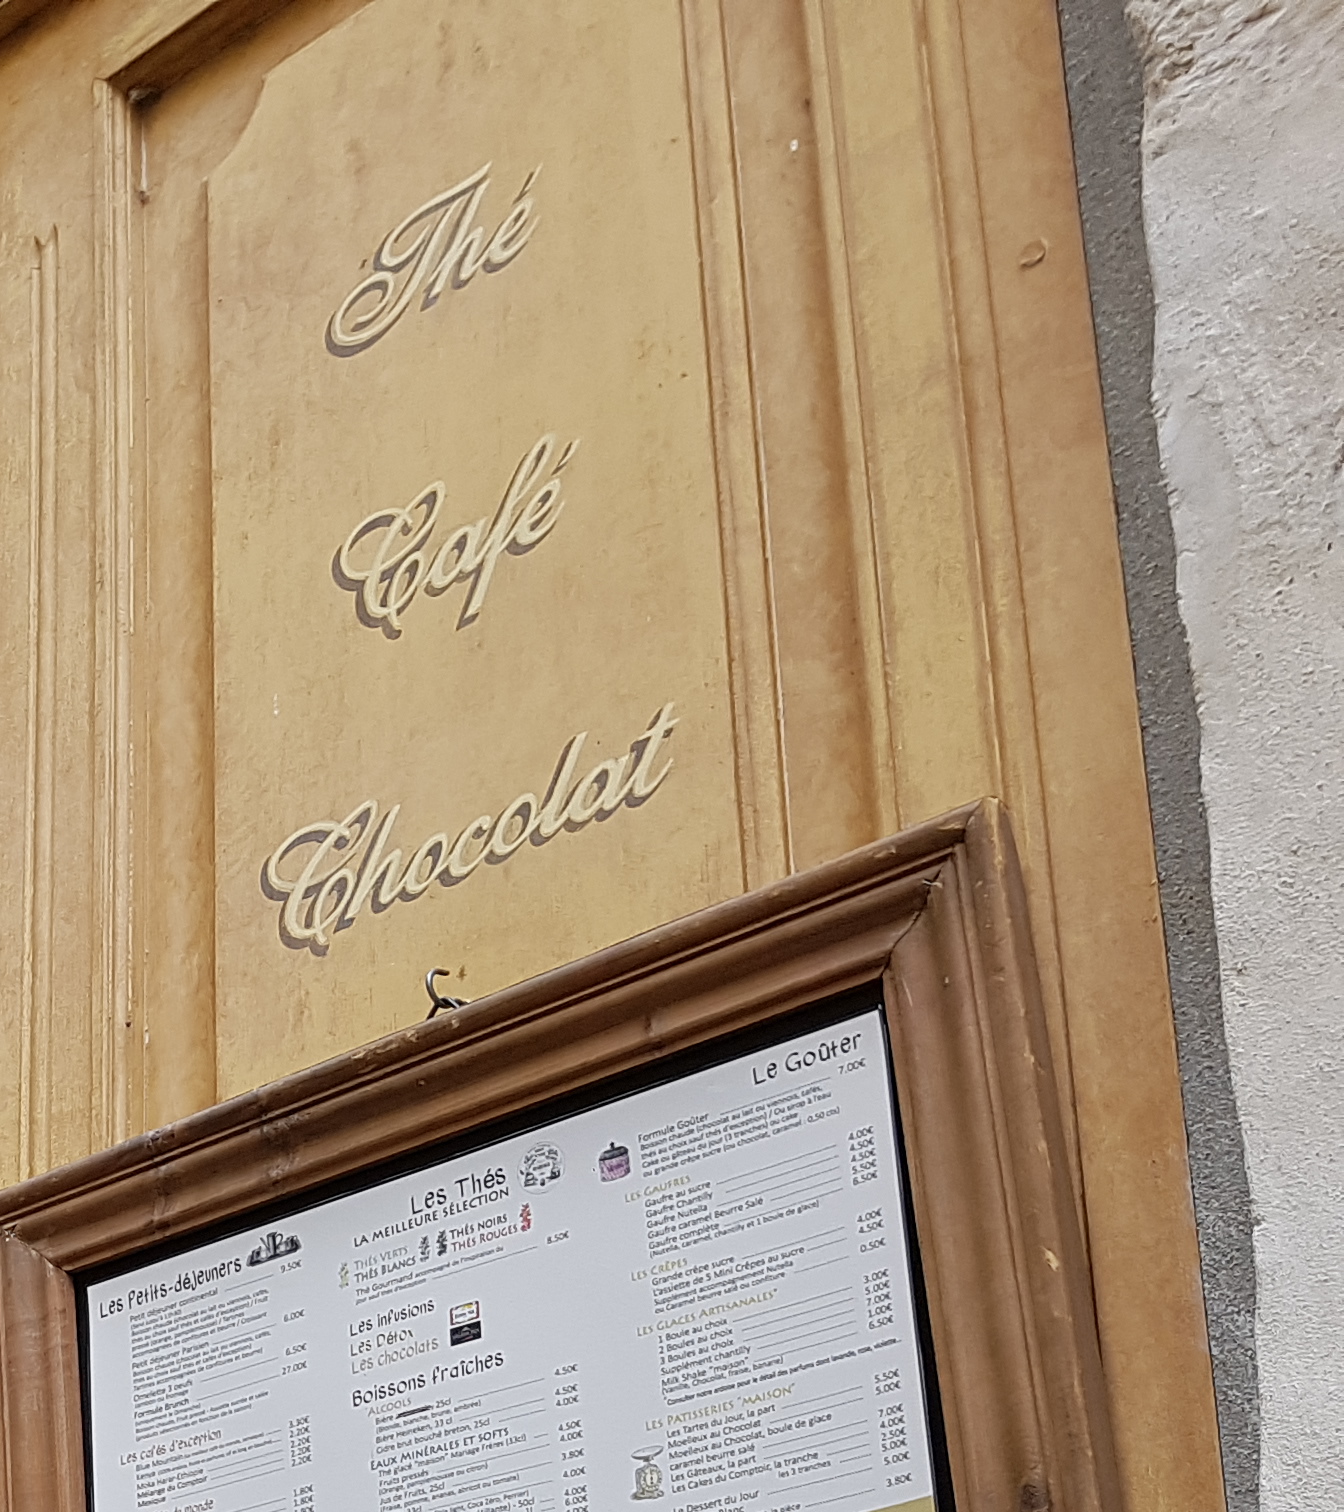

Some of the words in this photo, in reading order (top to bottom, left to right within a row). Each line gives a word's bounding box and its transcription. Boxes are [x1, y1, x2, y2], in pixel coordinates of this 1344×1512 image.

[325, 162, 543, 357] Thé
[331, 432, 580, 640] Café
[261, 702, 679, 956] Chocolat
[752, 1062, 778, 1086] Le
[784, 1033, 862, 1073] Goûter
[637, 1125, 675, 1143] Formule
[676, 1113, 709, 1130] Goûter
[410, 1187, 448, 1216] Les
[453, 1167, 507, 1198] Thés
[624, 1192, 641, 1203] LES
[643, 1175, 691, 1197] GAUFRES
[644, 1193, 674, 1208] Gaufre
[675, 1189, 686, 1199] au
[687, 1181, 711, 1195] sucre
[353, 1234, 370, 1248] LA
[371, 1209, 439, 1242] MEILLEURE
[442, 1186, 510, 1218] SÉLECTION
[645, 1204, 675, 1219] Gaufre
[676, 1191, 713, 1209] Chantilly
[646, 1214, 676, 1229] Gaufre
[677, 1204, 708, 1218] Nutella
[647, 1225, 677, 1240] Gaufre
[678, 1212, 713, 1230] caramel
[714, 1204, 744, 1219] Beurre
[744, 1197, 764, 1210] Salé
[449, 1223, 475, 1240] THÉS
[477, 1213, 508, 1232] NOIRS
[450, 1236, 477, 1253] THÉS
[479, 1223, 518, 1244] ROUGES
[648, 1236, 678, 1250] Gaufre
[678, 1223, 720, 1241] complète
[379, 1246, 408, 1262] VERTS
[353, 1267, 379, 1284] THÉS
[381, 1255, 416, 1276] BLANCS
[631, 1270, 648, 1282] LES
[651, 1271, 683, 1286] Grande
[711, 1256, 735, 1269] sucre
[99, 1297, 124, 1319] Les
[349, 1318, 374, 1337] Les
[376, 1299, 435, 1328] infusions
[636, 1325, 654, 1337] LES
[656, 1312, 696, 1331] GLACES
[665, 1329, 690, 1342] Boule
[691, 1325, 703, 1334] au
[704, 1318, 728, 1331] choix
[350, 1339, 372, 1357] Les
[351, 1357, 374, 1375] Les
[377, 1337, 439, 1367] chocolats
[352, 1373, 426, 1408] Boissons
[431, 1352, 504, 1385] fraîches
[645, 1419, 664, 1432] LES
[667, 1400, 734, 1426] PATISSERIES
[666, 1429, 681, 1439] Les
[682, 1421, 709, 1434] Tartes
[710, 1418, 723, 1428] du
[757, 1404, 776, 1417] part
[370, 1455, 398, 1471] EAUX
[400, 1439, 460, 1464] MINÉRALES
[462, 1435, 476, 1447] ET
[477, 1427, 509, 1443] SOFTS
[667, 1434, 708, 1450] Moelleux
[709, 1430, 721, 1439] au
[722, 1419, 762, 1436] Chocolat
[120, 1452, 138, 1466] Les
[670, 1473, 685, 1483] Les
[737, 1455, 757, 1468] part
[724, 1495, 737, 1505] du
